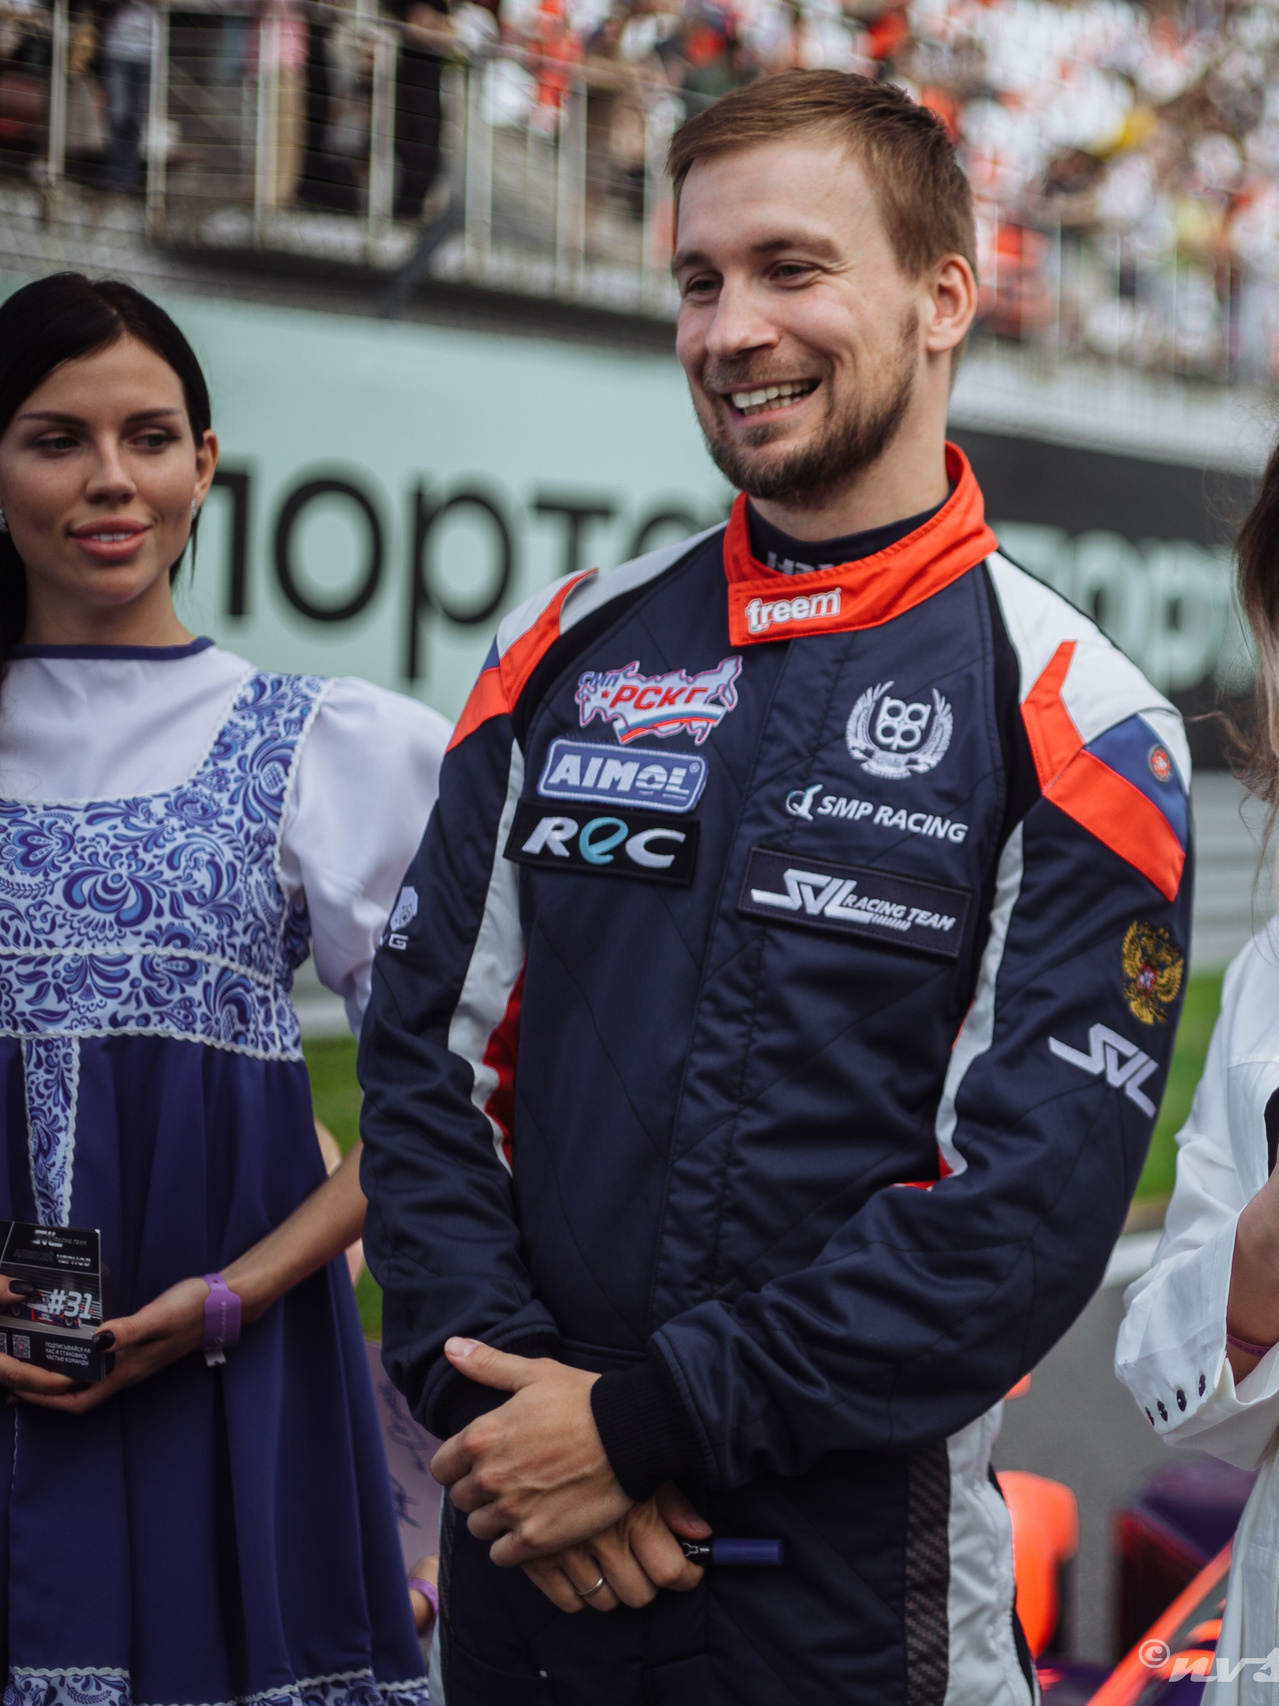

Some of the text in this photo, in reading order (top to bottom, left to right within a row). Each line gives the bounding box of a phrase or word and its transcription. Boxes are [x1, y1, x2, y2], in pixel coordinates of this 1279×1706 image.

[745, 588, 842, 634] freem
[608, 684, 709, 711] РСКГ
[817, 795, 969, 844] SMP RACING
[843, 893, 907, 917] RACING
[907, 907, 956, 932] TEAM
[48, 1289, 93, 1319] #31
